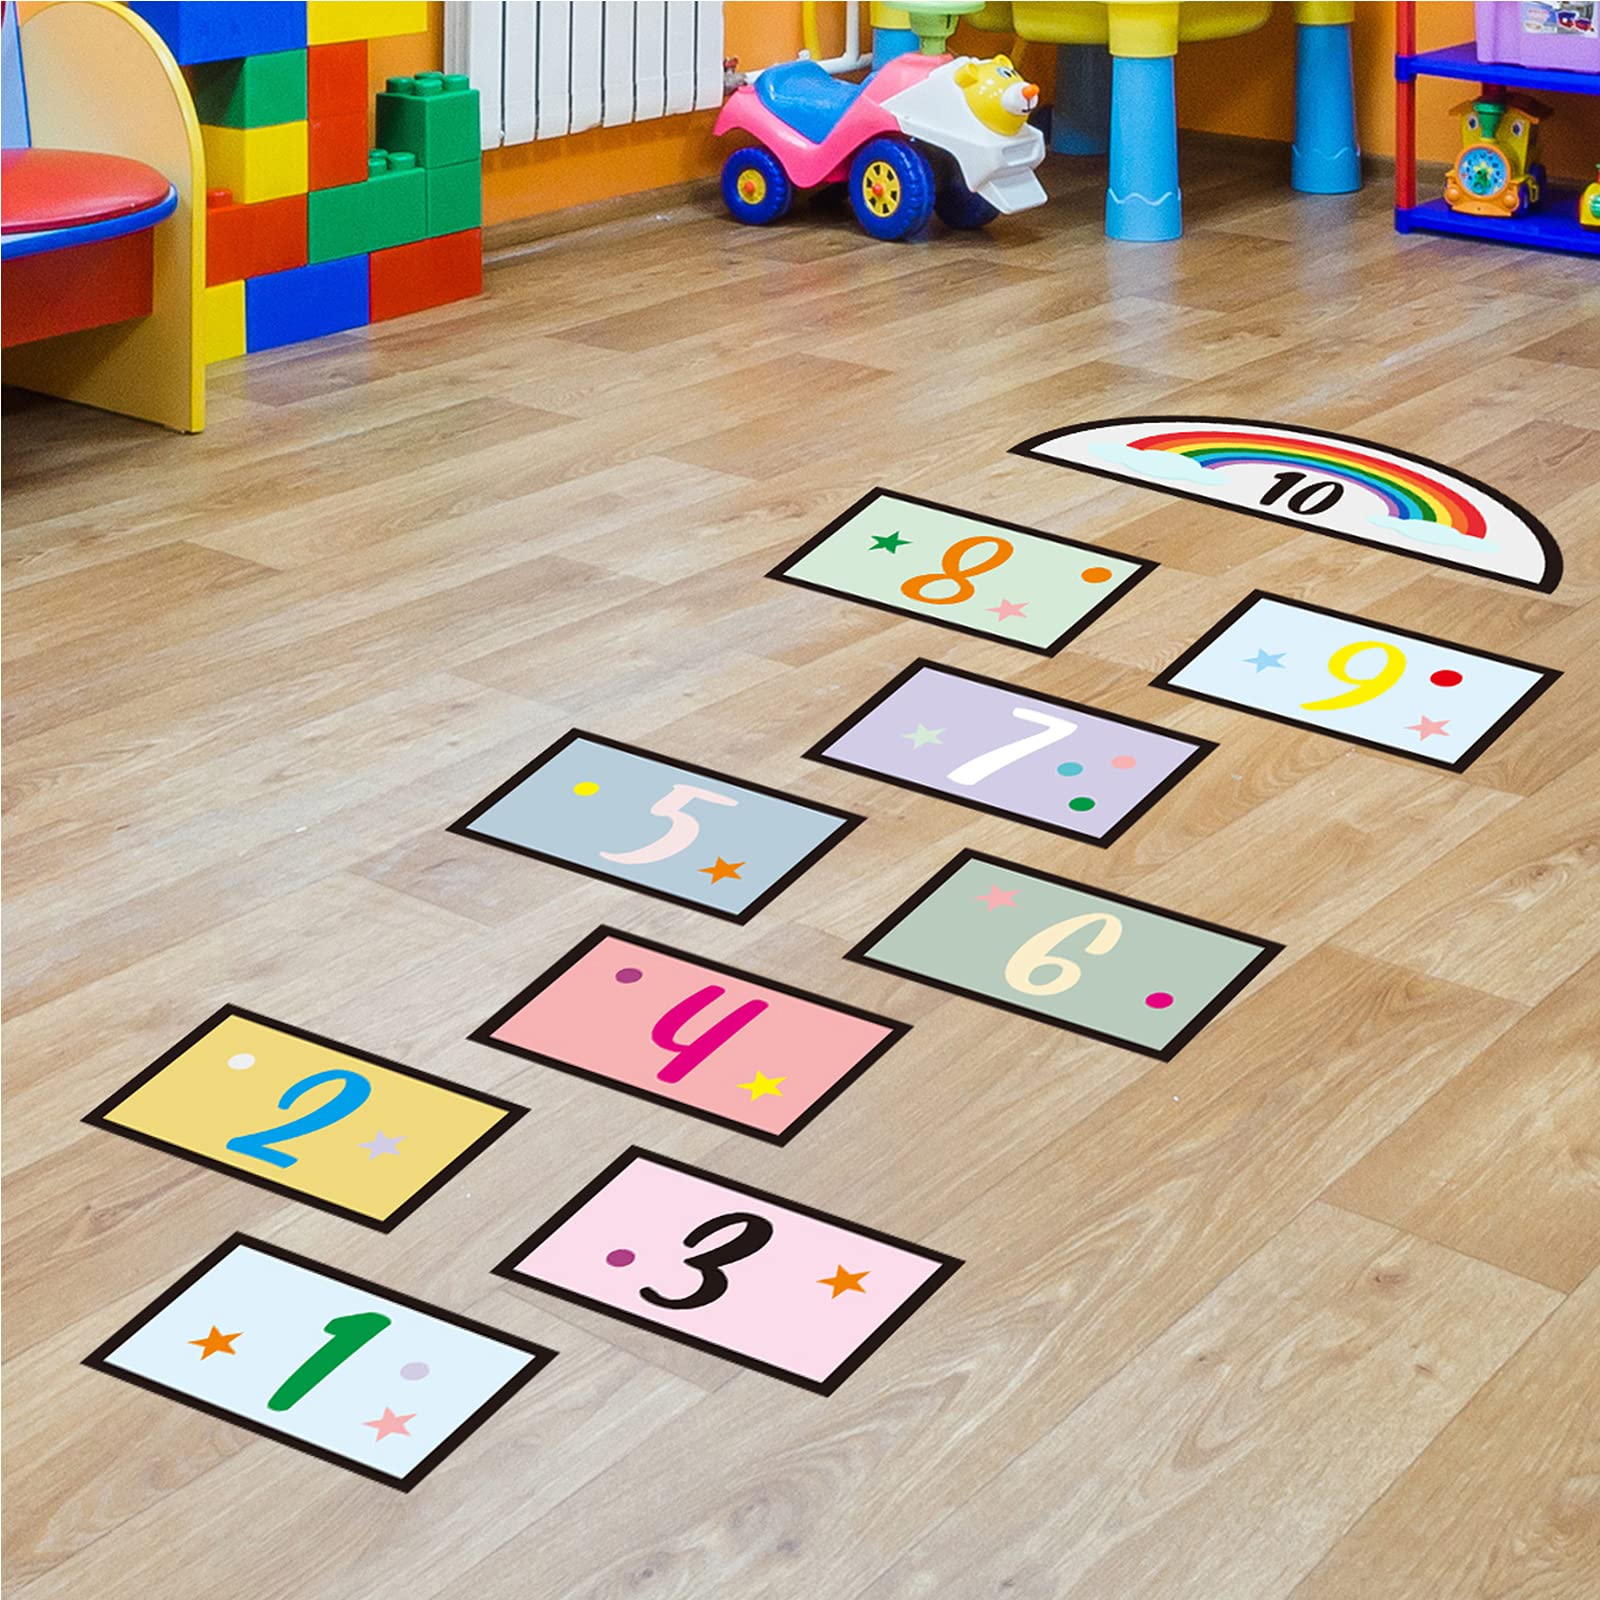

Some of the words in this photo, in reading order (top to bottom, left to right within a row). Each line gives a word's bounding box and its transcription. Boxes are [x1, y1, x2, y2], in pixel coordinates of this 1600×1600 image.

[1258, 470, 1345, 516] 10
[899, 535, 1015, 606] 8
[1299, 640, 1407, 712] 9
[946, 707, 1079, 786] 7
[599, 783, 739, 865] 5
[1004, 912, 1123, 997] 6
[651, 984, 770, 1084] 4
[225, 1068, 373, 1170] 2
[638, 1211, 775, 1311] 3
[266, 1311, 393, 1413] 1
